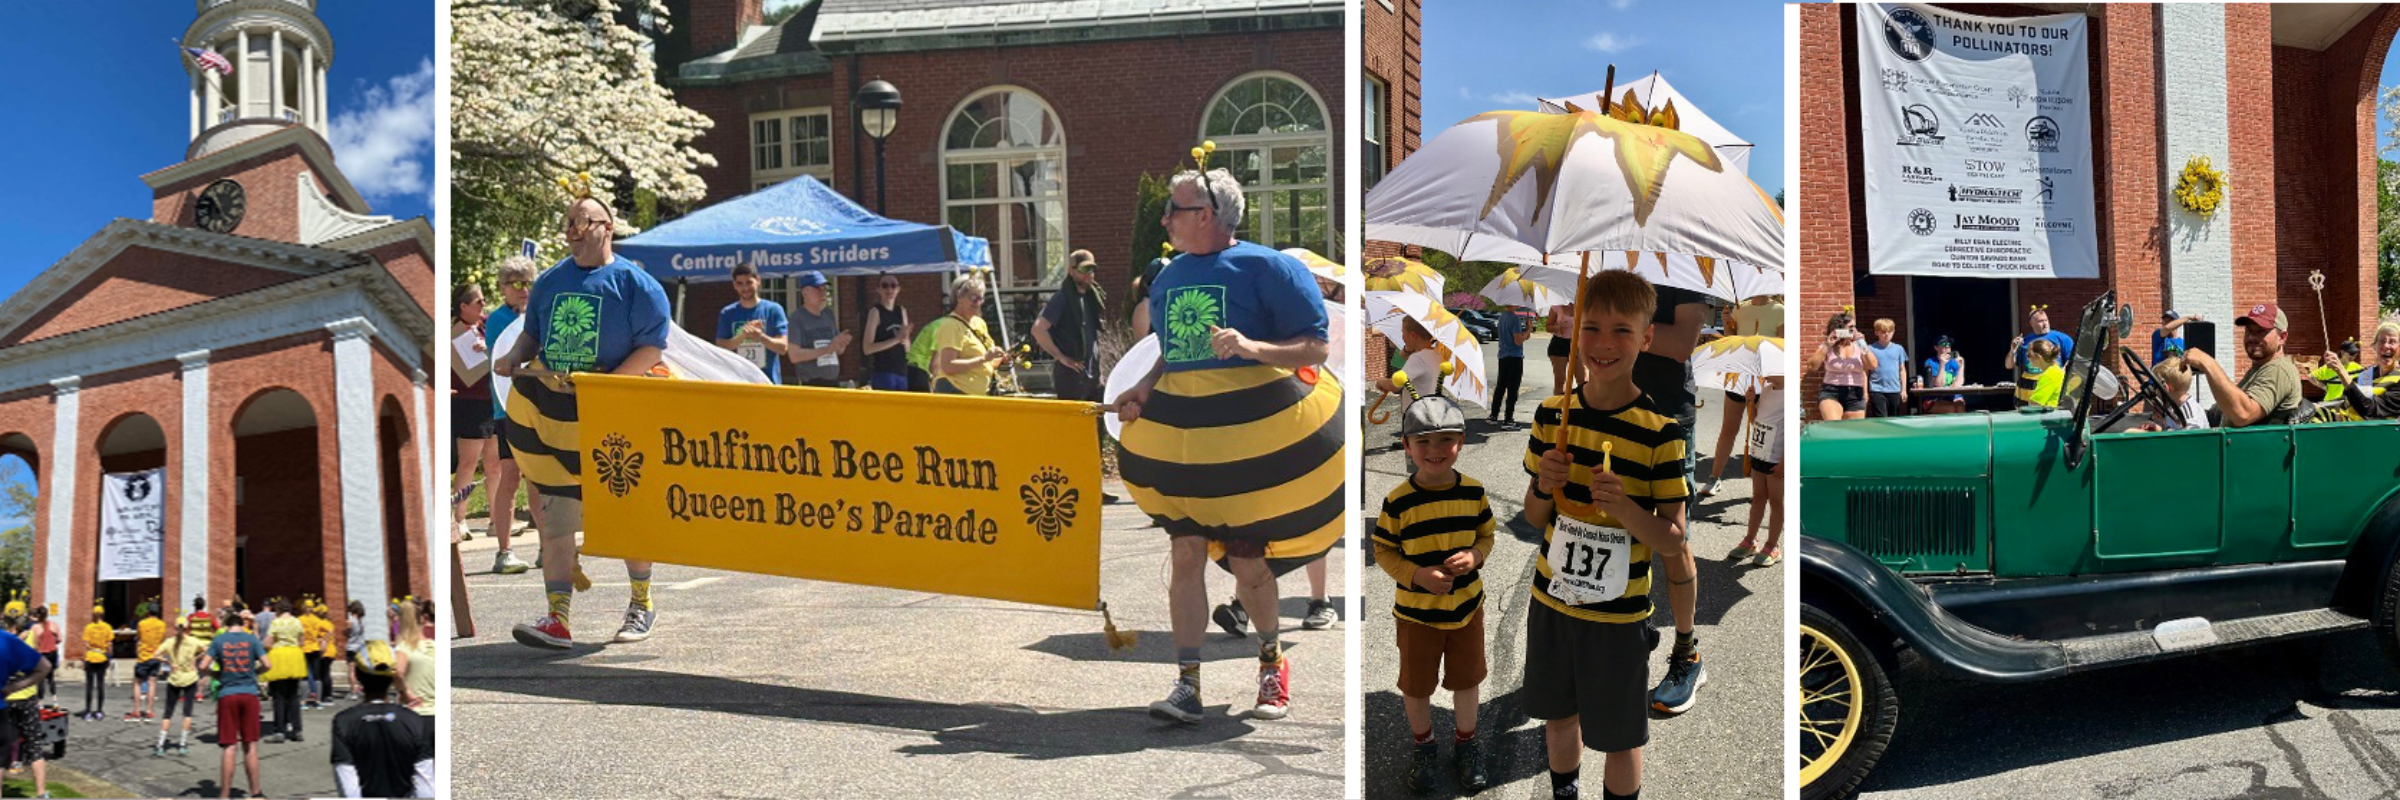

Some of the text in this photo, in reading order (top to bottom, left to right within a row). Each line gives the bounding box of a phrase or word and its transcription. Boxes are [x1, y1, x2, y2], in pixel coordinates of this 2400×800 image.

[1933, 14, 1983, 33] THANK
[1987, 23, 2015, 36] YOU
[2019, 25, 2036, 38] TO
[2041, 28, 2069, 40] OUR
[1953, 35, 2053, 56] POLLINATORS!
[1902, 165, 1911, 174] R
[1923, 167, 1933, 176] R
[1965, 158, 2006, 172] STOW
[1953, 213, 1976, 229] JAY
[1977, 214, 2021, 226] MOODY
[671, 244, 890, 271] Central Mass Striders
[745, 349, 756, 359] 23
[661, 427, 999, 491] Bulfinch Bee Run
[665, 484, 999, 545] Queen Bee's Parade
[1561, 541, 1612, 581] 137
